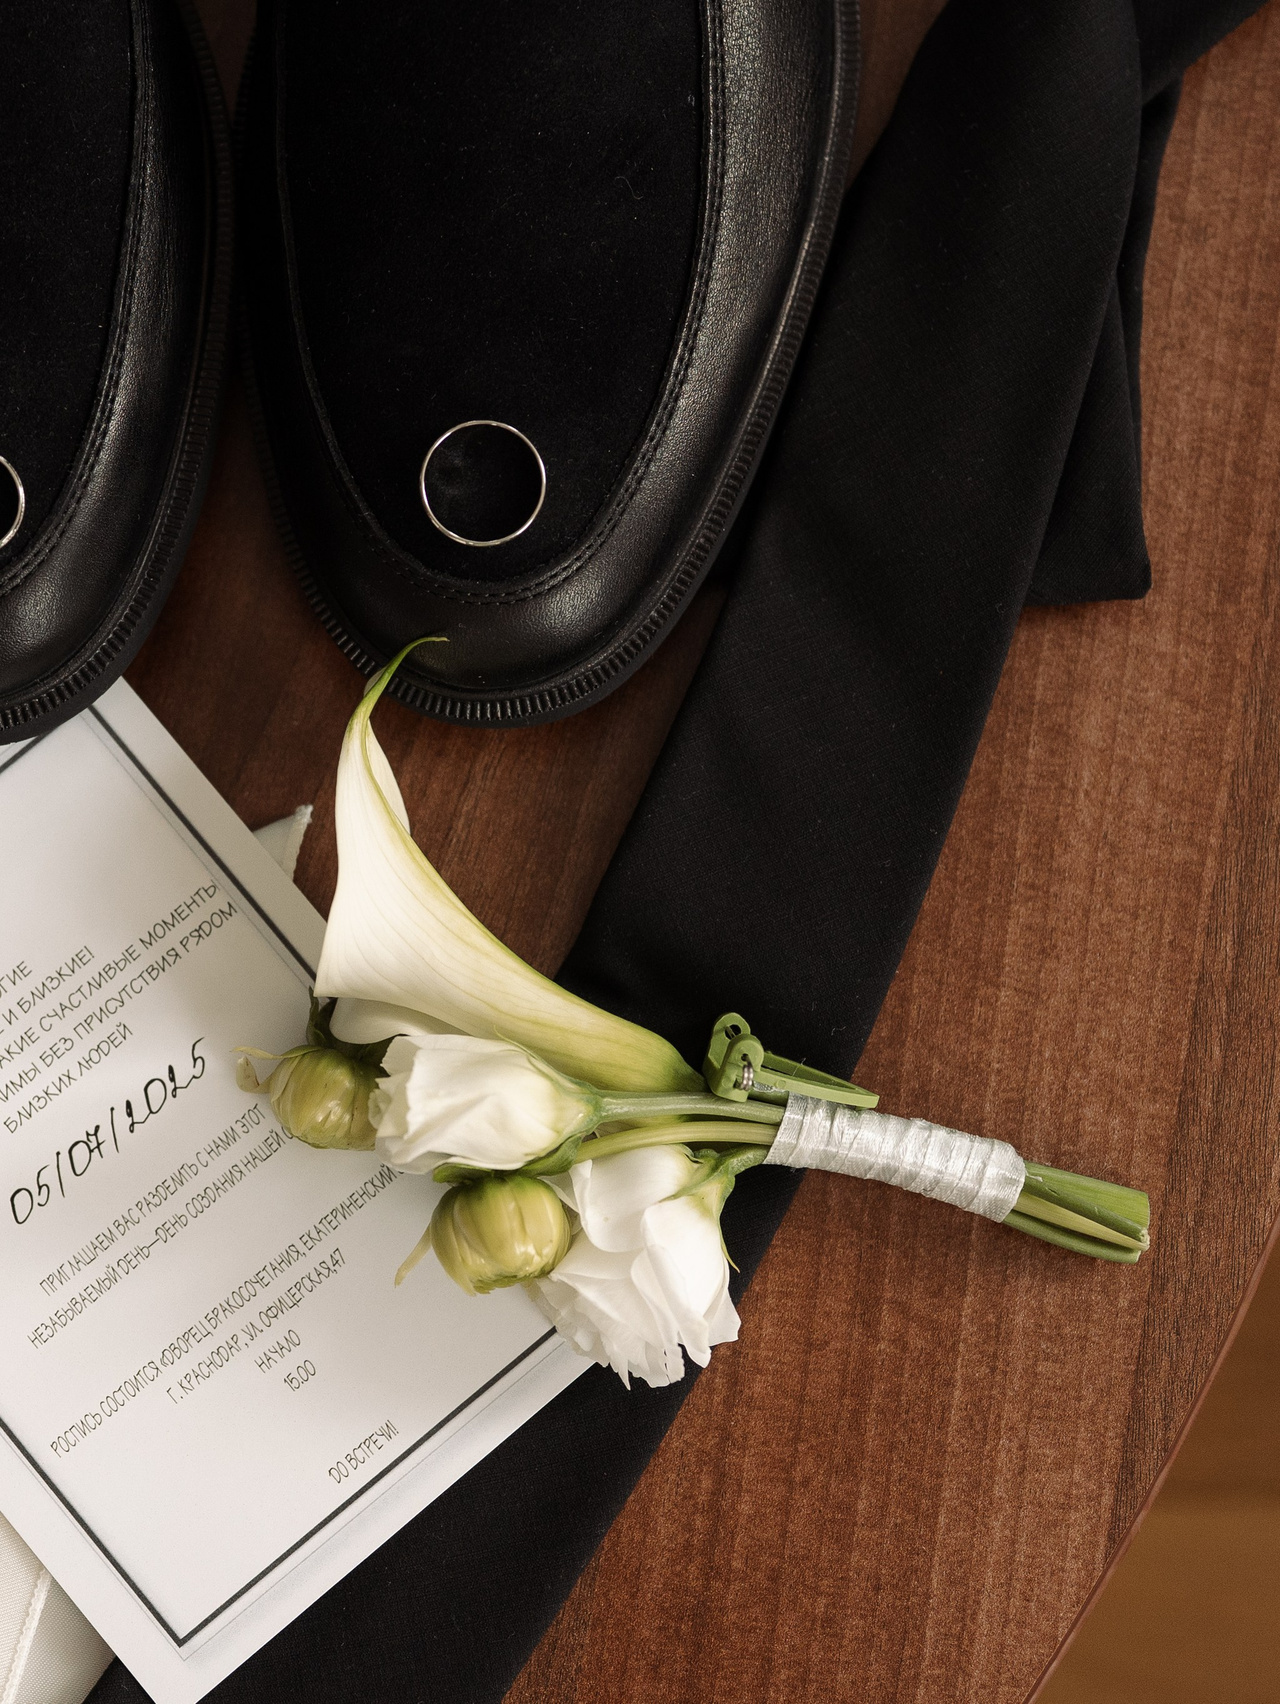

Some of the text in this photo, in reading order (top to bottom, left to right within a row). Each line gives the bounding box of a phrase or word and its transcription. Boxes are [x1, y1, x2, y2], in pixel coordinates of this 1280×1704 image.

[1, 1008, 19, 1026] И
[16, 945, 95, 1015] БЛИЗКИЕ!
[38, 1036, 75, 1068] БЕЗ
[72, 946, 183, 1040] ПРИСУТСТВИЯ
[179, 901, 238, 953] РЯДОМ
[39, 944, 142, 1033] СЧАСТЛИВЫЕ
[138, 879, 219, 950] МОМЕНТЫ
[3, 1021, 134, 1134] БЛИЗКИХ ЛЮДЕЙ
[9, 1036, 206, 1225] 05/07/2025
[26, 1263, 123, 1350] НЕЗАБЫВАЕМЫЙ
[185, 1163, 247, 1219] СОЗДАНИЯ
[239, 1128, 286, 1173] НАШЕЙ
[38, 1226, 119, 1297] ПРИГЛАШАЕМ
[112, 1207, 141, 1237] ВАС
[134, 1162, 199, 1218] РАЗДЕЛИТЬ
[195, 1151, 209, 1168] С
[202, 1125, 242, 1161] НАМИ
[234, 1102, 266, 1134] ЭТОТ
[49, 1411, 103, 1459] РОСПИСЬ
[99, 1360, 163, 1418] СОСТОИТСЯ
[203, 1243, 307, 1330] БРАКОСОЧЕТАНИЯ,
[298, 1162, 398, 1252] ЕКАТЕРИНЕНСКИЙ
[166, 1386, 184, 1405] Г.
[240, 1321, 264, 1342] УЛ.
[253, 1329, 301, 1374] НАЧАЛО
[283, 1359, 317, 1392] 15.00
[327, 1419, 400, 1484] ДО ВСТРЕЧИ!
